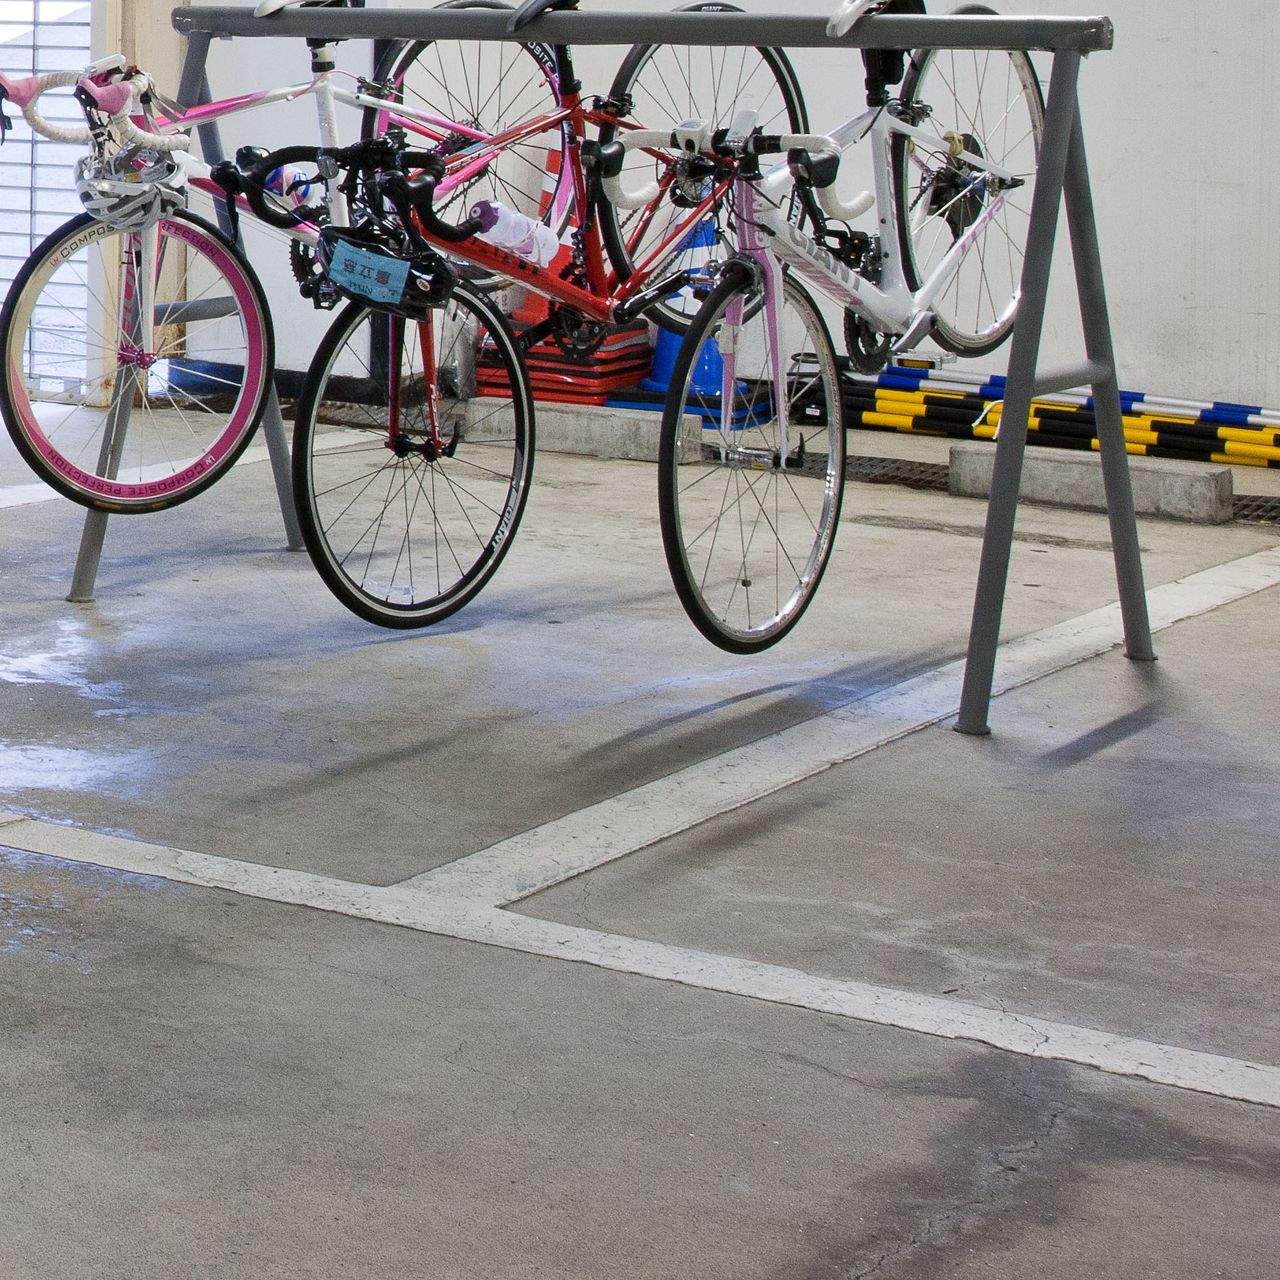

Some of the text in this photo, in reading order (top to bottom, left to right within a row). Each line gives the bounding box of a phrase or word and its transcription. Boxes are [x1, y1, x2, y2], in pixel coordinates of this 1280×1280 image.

[60, 224, 115, 259] COMPOS
[46, 449, 205, 497] COMPOSITE PERFECTION
